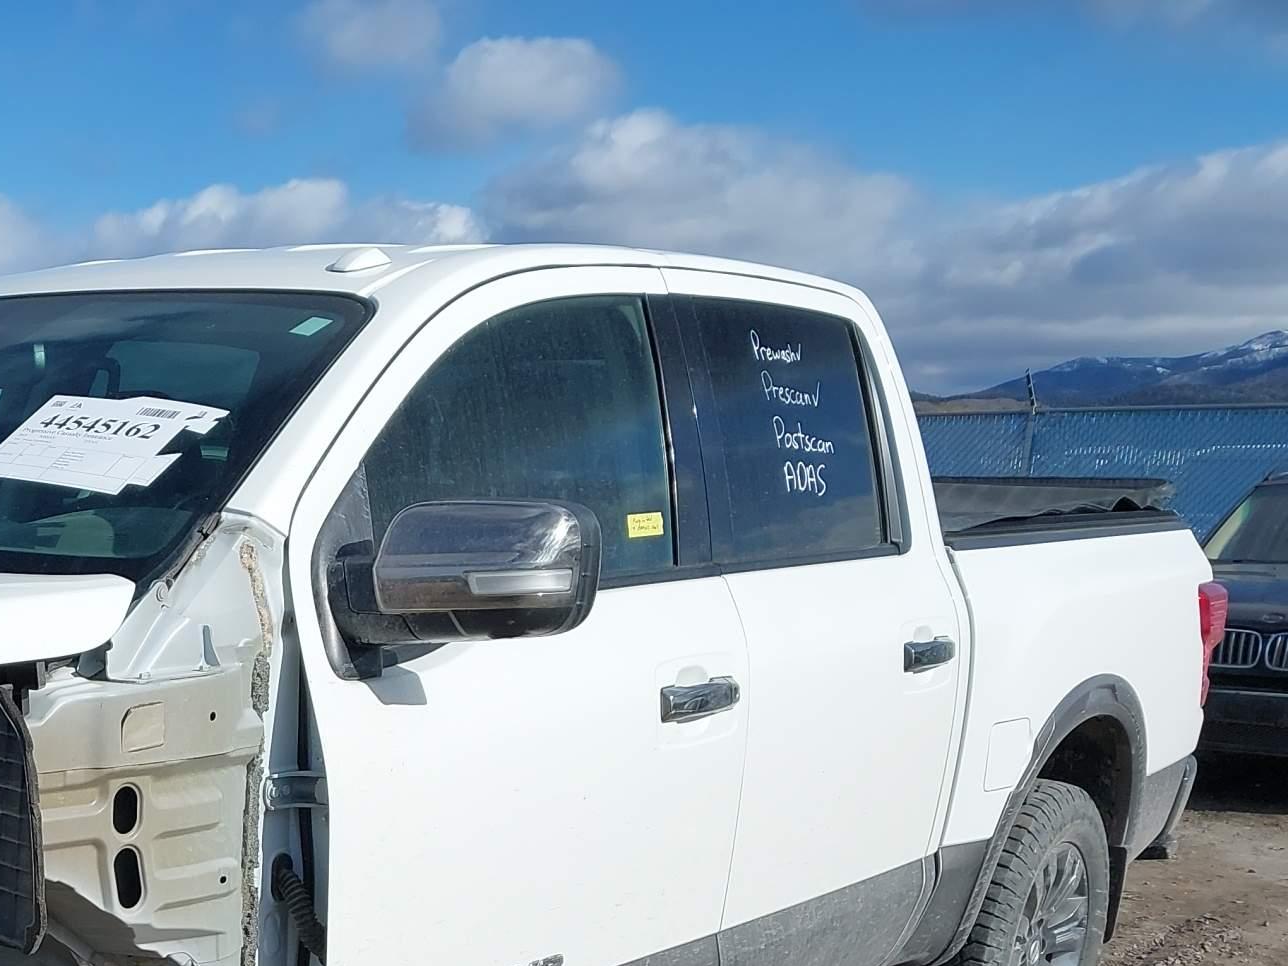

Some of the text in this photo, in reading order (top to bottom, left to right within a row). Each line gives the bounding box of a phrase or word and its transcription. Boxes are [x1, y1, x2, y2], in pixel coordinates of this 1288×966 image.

[760, 370, 812, 406] Prescan
[40, 414, 161, 440] 44545162
[772, 415, 835, 454] Postscan
[784, 460, 827, 496] ADAS
